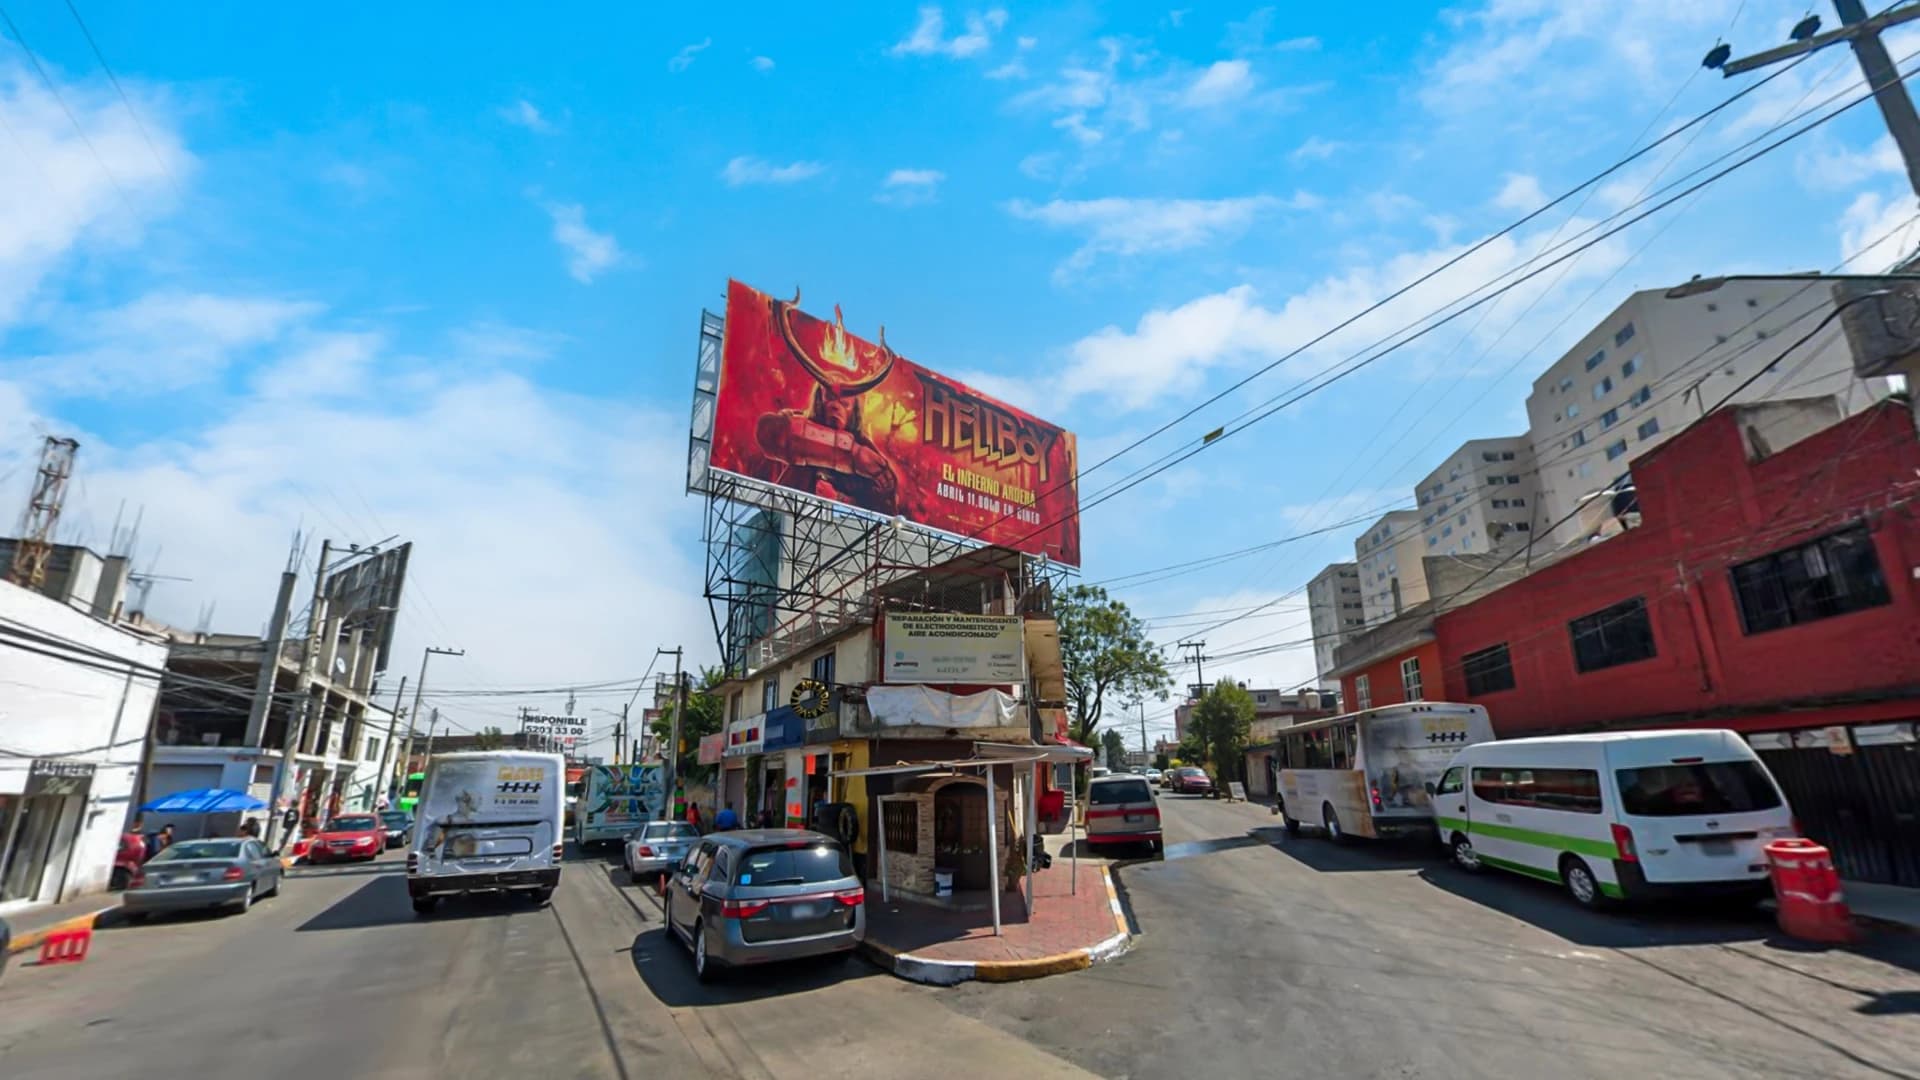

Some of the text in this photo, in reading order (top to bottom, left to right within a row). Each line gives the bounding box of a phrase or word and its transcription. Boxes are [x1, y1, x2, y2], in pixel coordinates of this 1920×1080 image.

[914, 371, 1066, 482] HELLBOY
[937, 482, 964, 503] ABRIL
[978, 495, 1000, 513] SOLO
[1016, 507, 1040, 525] CINES
[943, 463, 1036, 508] EL INFIERNO ARDERÁ
[555, 727, 567, 735] 33
